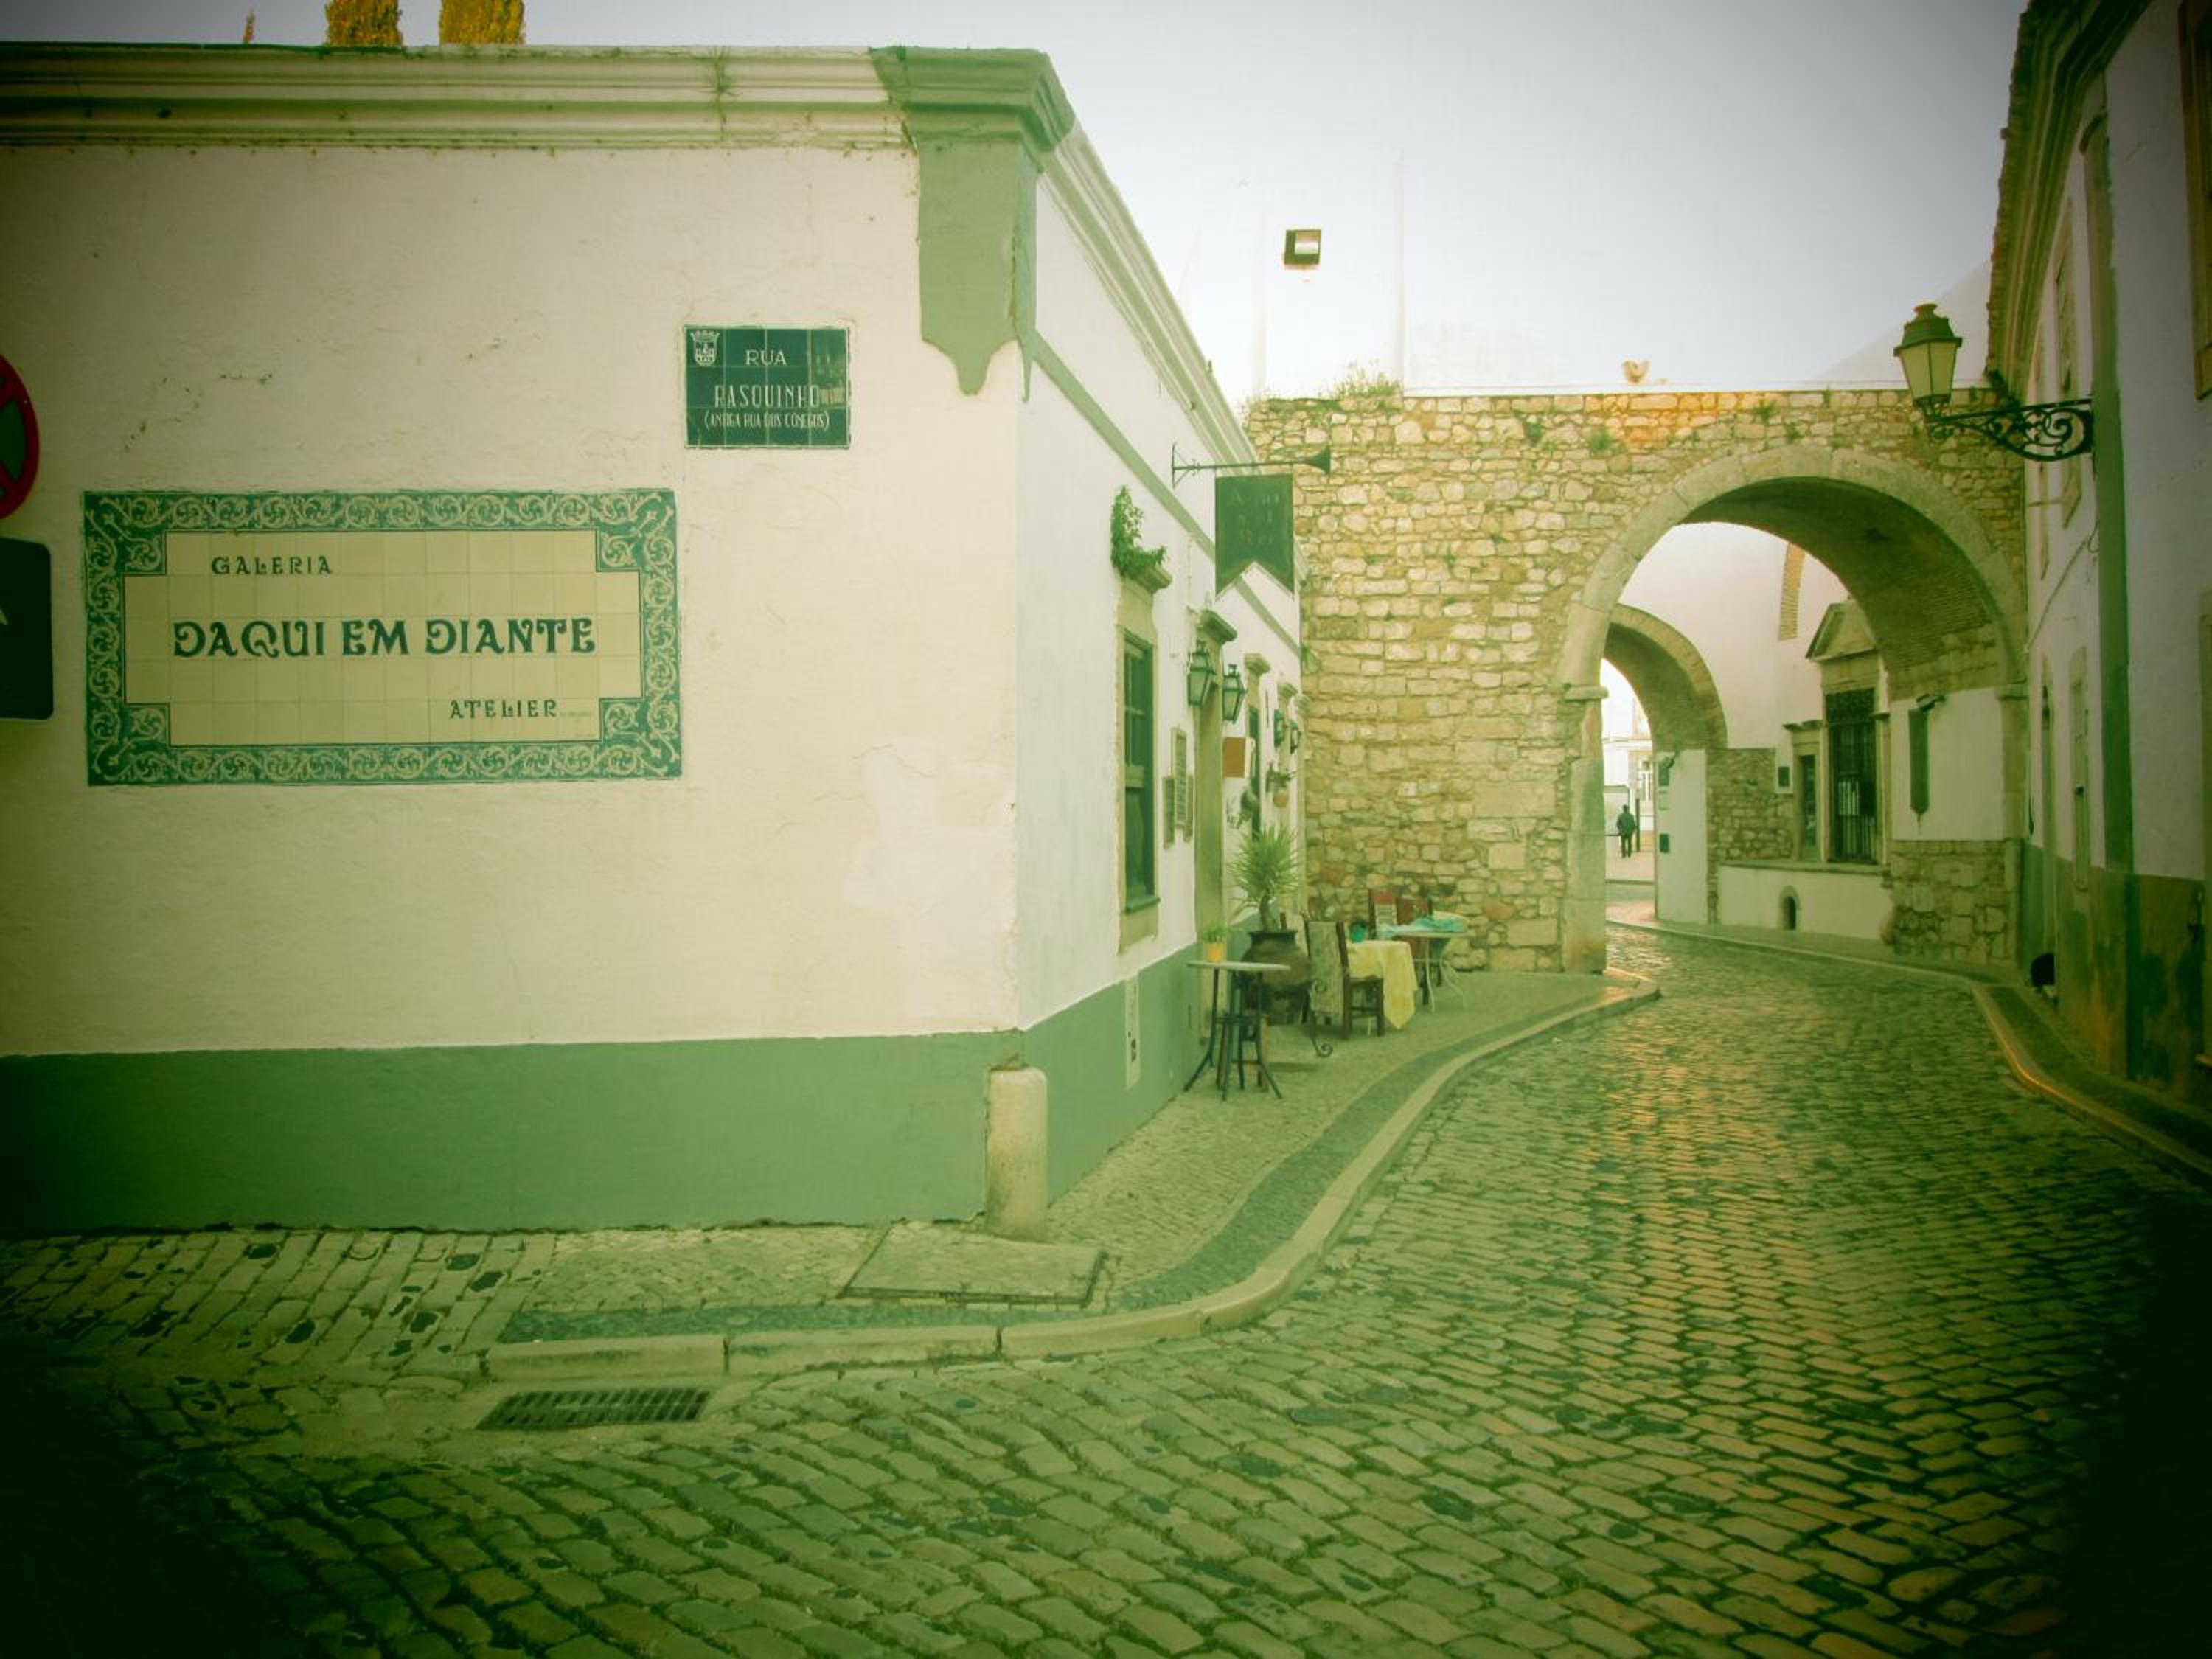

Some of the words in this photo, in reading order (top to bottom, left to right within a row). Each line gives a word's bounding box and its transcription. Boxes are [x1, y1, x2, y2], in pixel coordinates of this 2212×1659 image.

[745, 349, 787, 366] RUA
[744, 413, 762, 428] RUA
[764, 412, 782, 428] DOS
[212, 555, 332, 575] GALERIA
[173, 620, 325, 658] DAQUI
[341, 619, 409, 655] EM
[425, 618, 595, 655] DIANTE
[450, 699, 557, 720] ATELIER
